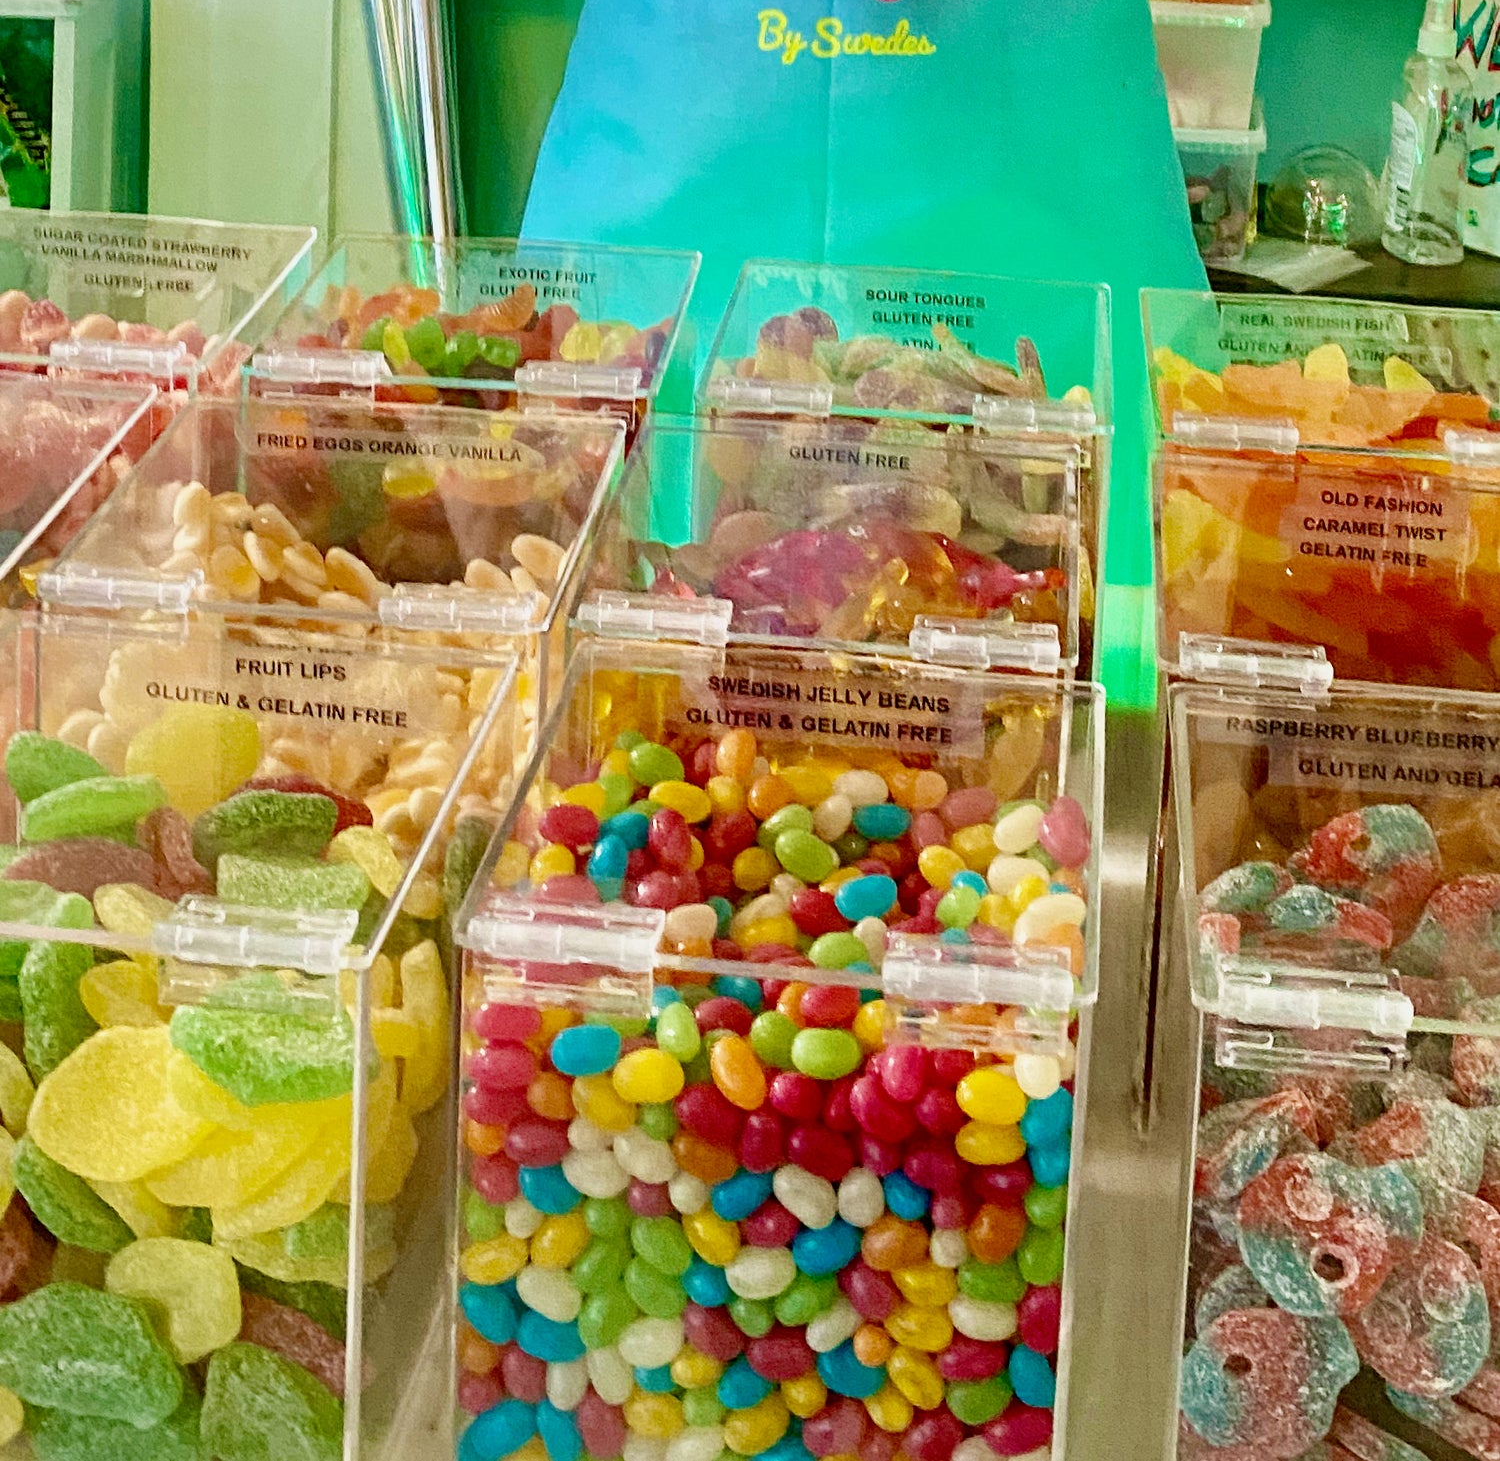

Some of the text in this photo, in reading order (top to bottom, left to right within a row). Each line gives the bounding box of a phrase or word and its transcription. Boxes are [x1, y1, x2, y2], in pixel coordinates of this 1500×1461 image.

[757, 8, 937, 65] By Swedes
[34, 227, 253, 260] SUGAR COATED STRAWBERRY
[41, 244, 218, 273] VANILLA MARSHMALLOW
[84, 273, 143, 290] GLUTEN
[499, 266, 597, 284] EXOTIC FRUIT
[543, 286, 581, 300] FREE
[866, 289, 985, 309] SOUR TONGUES
[873, 310, 975, 329] GLUTEN FREE
[1240, 313, 1391, 333] REAL SWEDISH FISH
[1218, 339, 1280, 355] GLUTEN
[256, 432, 522, 462] FRIED EGGS ORANGE VANILLA
[789, 446, 910, 470] GLUTEN FREE
[1321, 490, 1443, 517] OLD FASHION
[1303, 516, 1448, 541] CARAMEL TWIST
[1299, 541, 1429, 568] GELATIN FREE
[235, 657, 346, 681] FRUIT LIPS
[146, 681, 408, 729] GLUTEN & GELATIN FREE
[708, 675, 951, 714] SWEDISH JELLY BEANS
[686, 707, 953, 744] GLUTEN & GELATIN FREE
[1226, 716, 1500, 753] RASPBERRY BLUEBERRY
[1299, 758, 1388, 782] GLUTEN
[1393, 764, 1440, 784] AND
